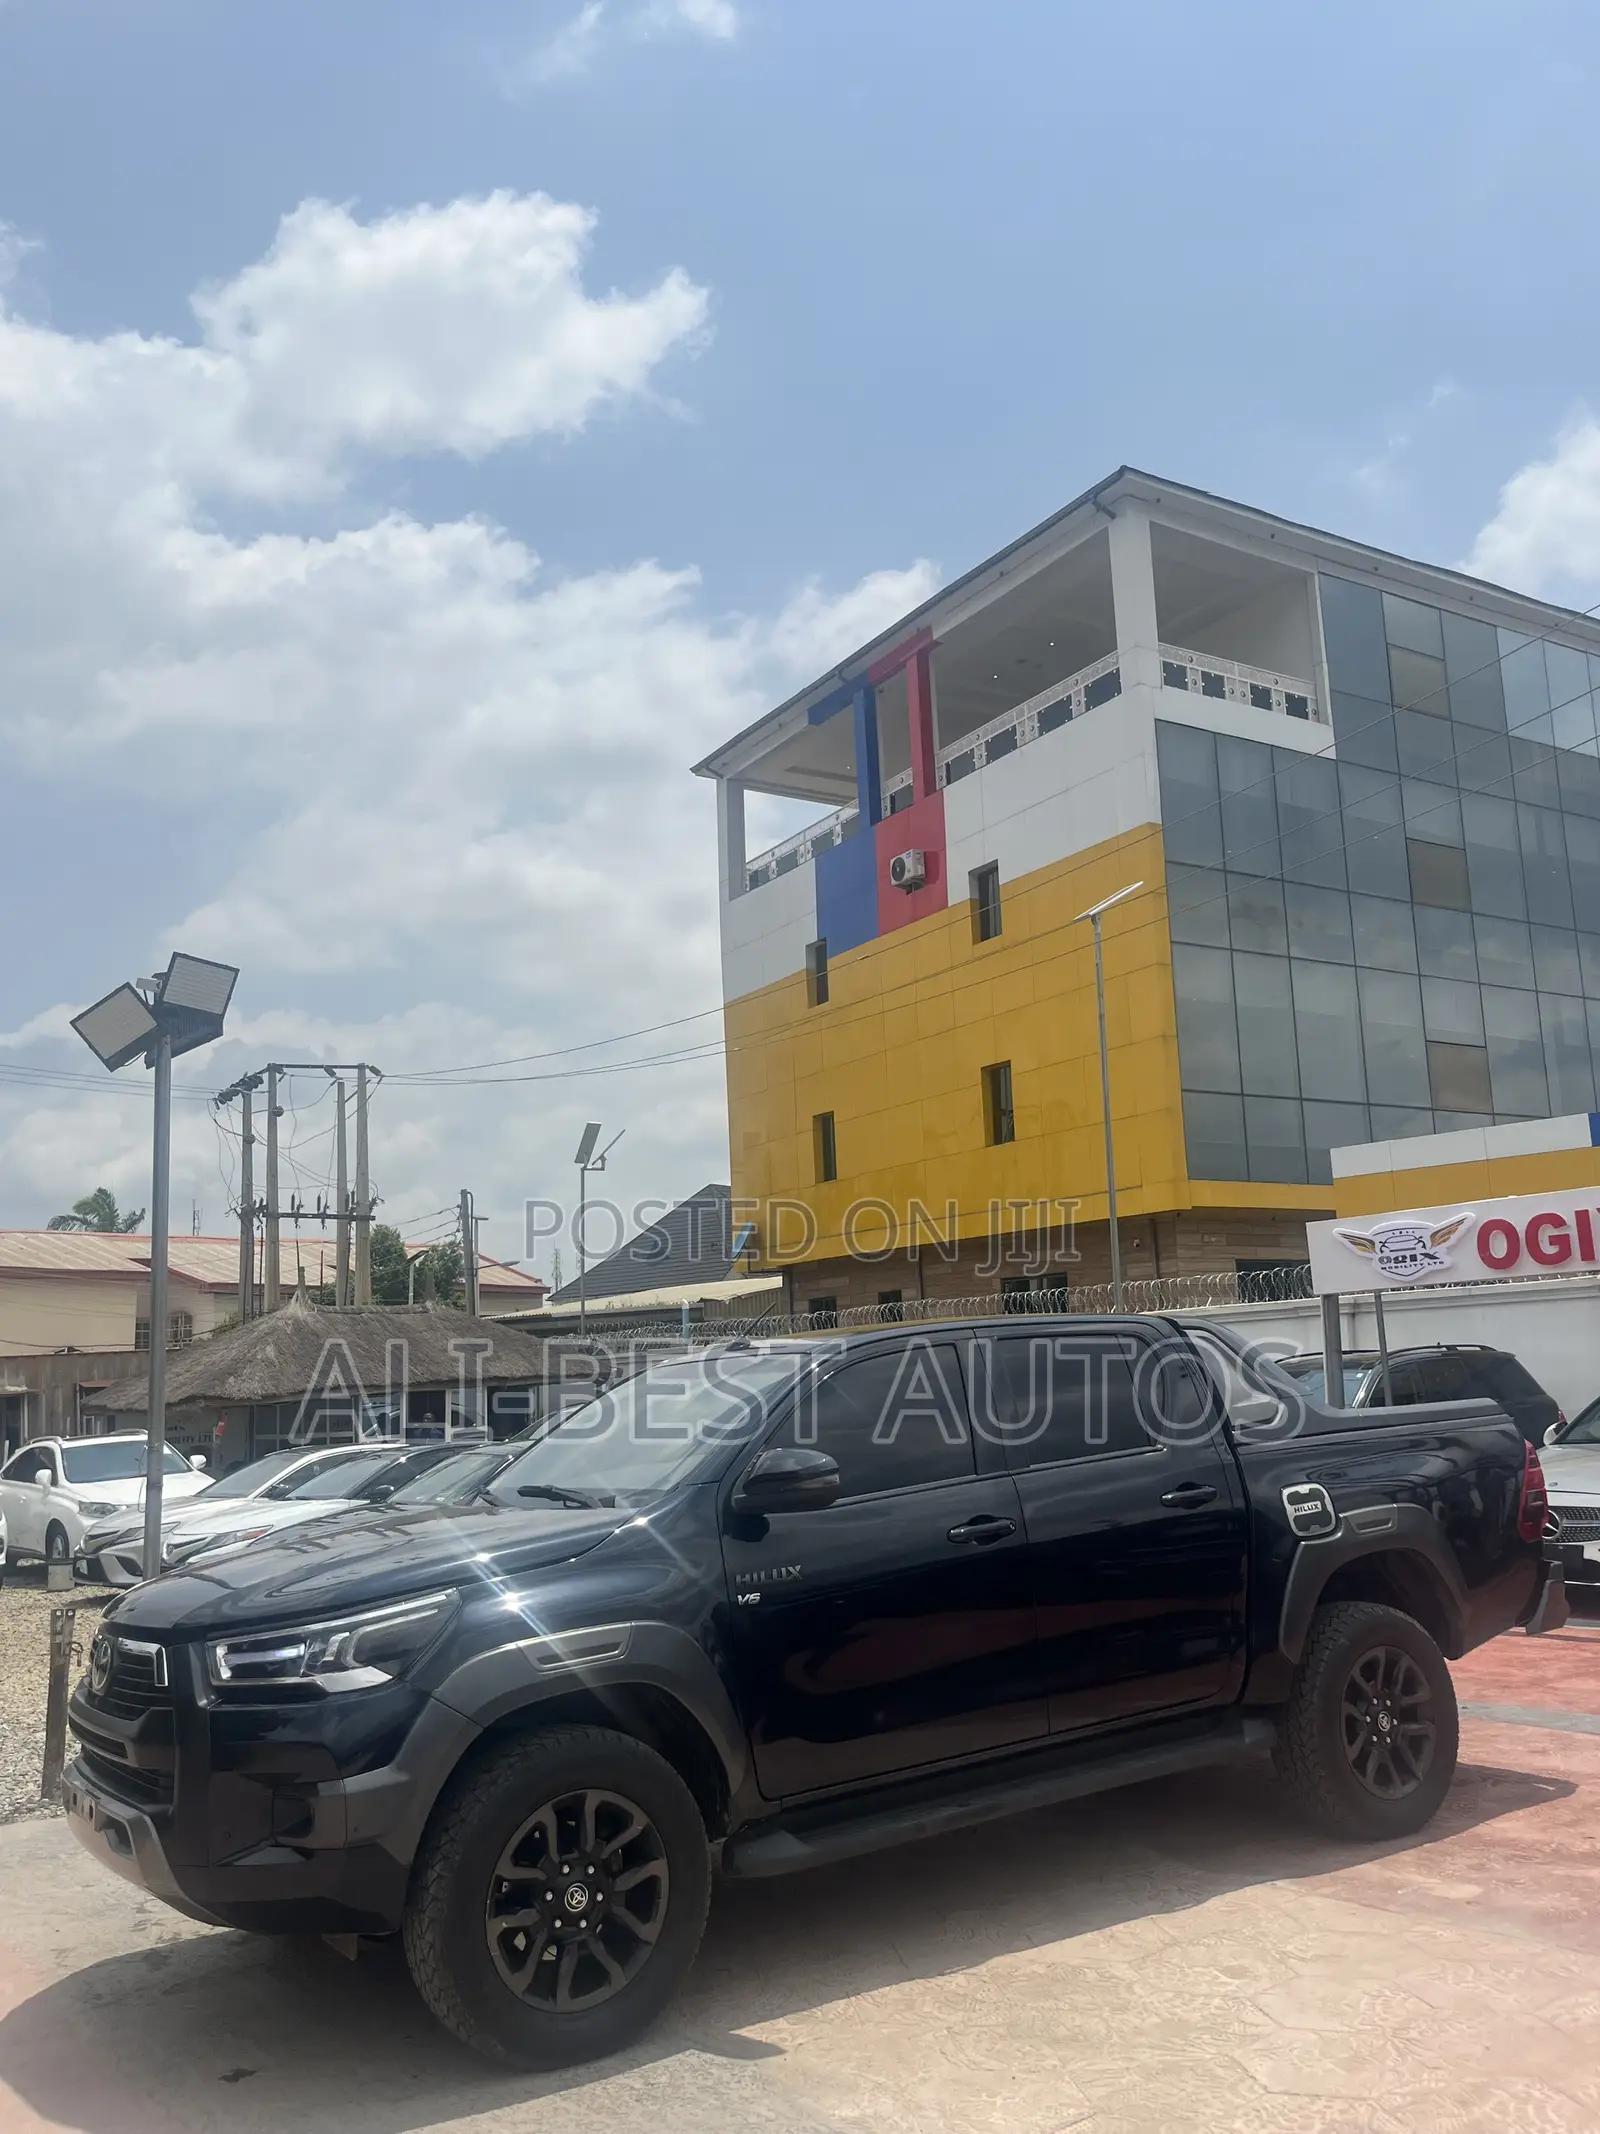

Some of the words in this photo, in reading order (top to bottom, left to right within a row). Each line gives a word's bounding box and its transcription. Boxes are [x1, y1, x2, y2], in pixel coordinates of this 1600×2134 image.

[1477, 1207, 1600, 1270] OGI
[1381, 1262, 1424, 1271] MOBILITY
[1294, 1503, 1320, 1514] HILUX
[735, 1565, 803, 1586] HILUX
[737, 1592, 761, 1606] V6
